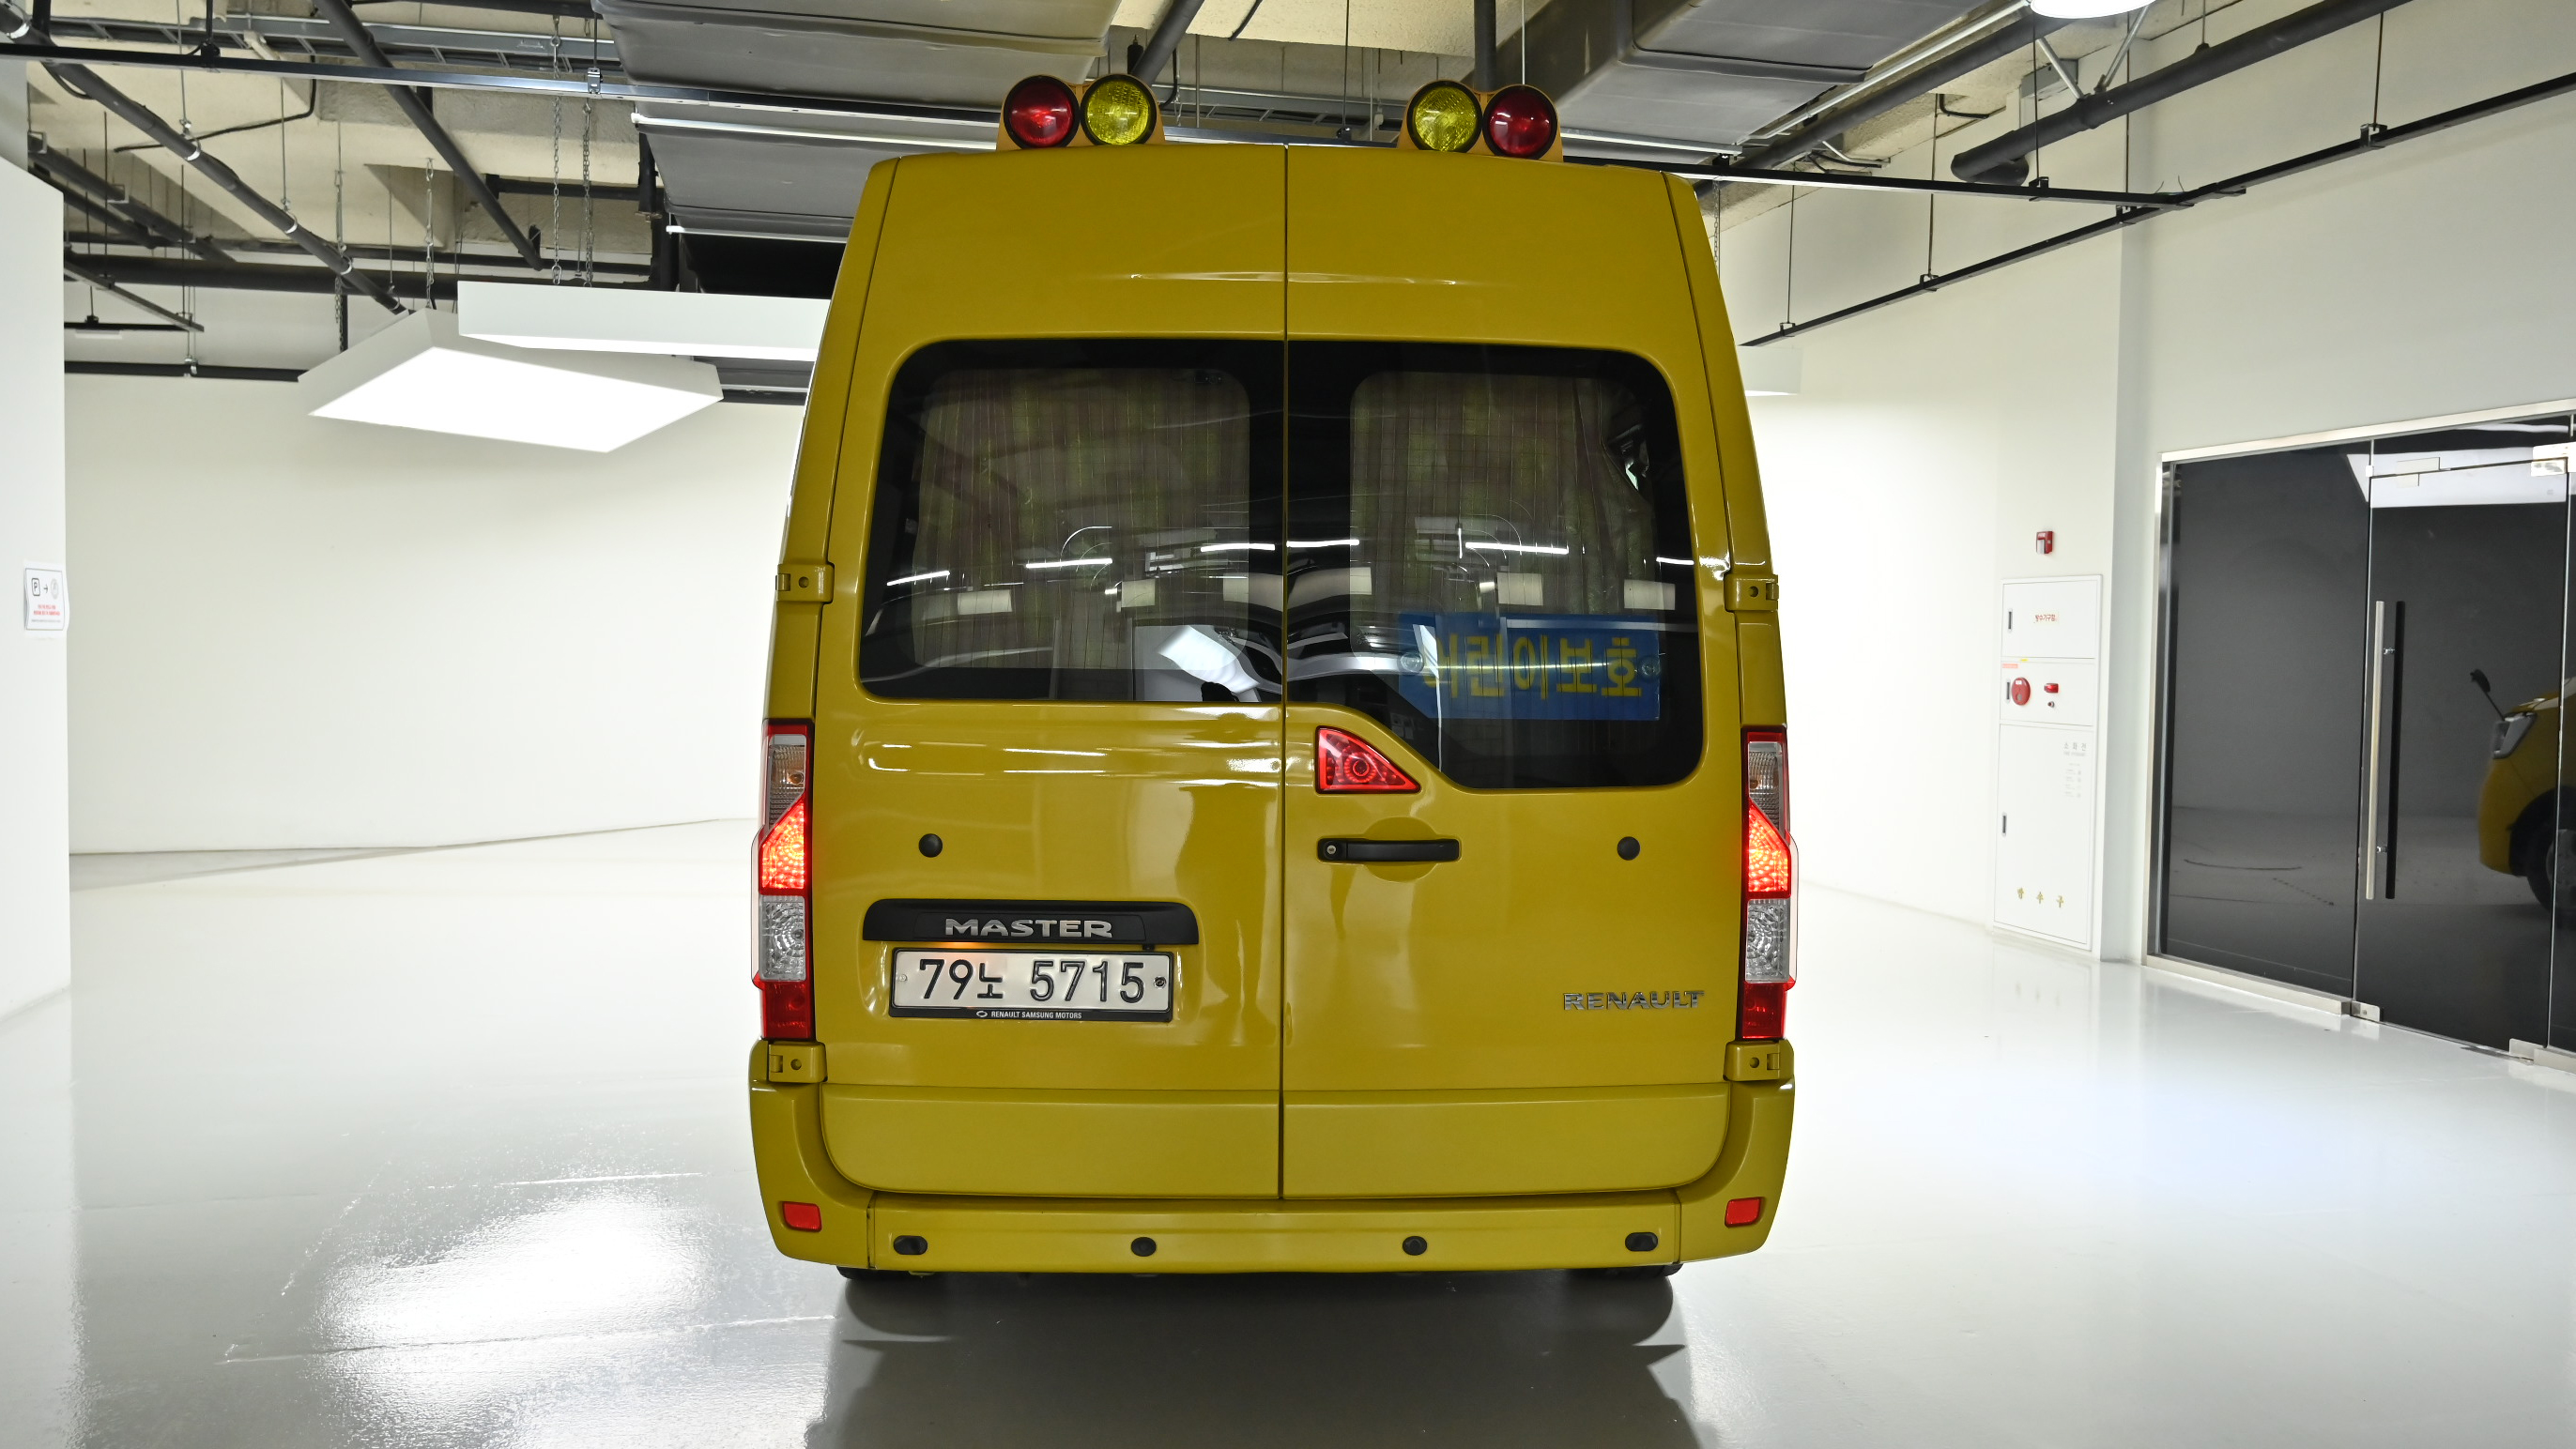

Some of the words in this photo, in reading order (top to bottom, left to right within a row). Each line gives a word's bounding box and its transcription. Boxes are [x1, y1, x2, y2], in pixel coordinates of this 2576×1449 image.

[1423, 633, 1642, 700] 어린이보호
[944, 918, 1112, 938] MASTER
[919, 958, 1004, 1000] 79노
[1029, 960, 1144, 1004] 5715
[1563, 990, 1705, 1011] RENAULT
